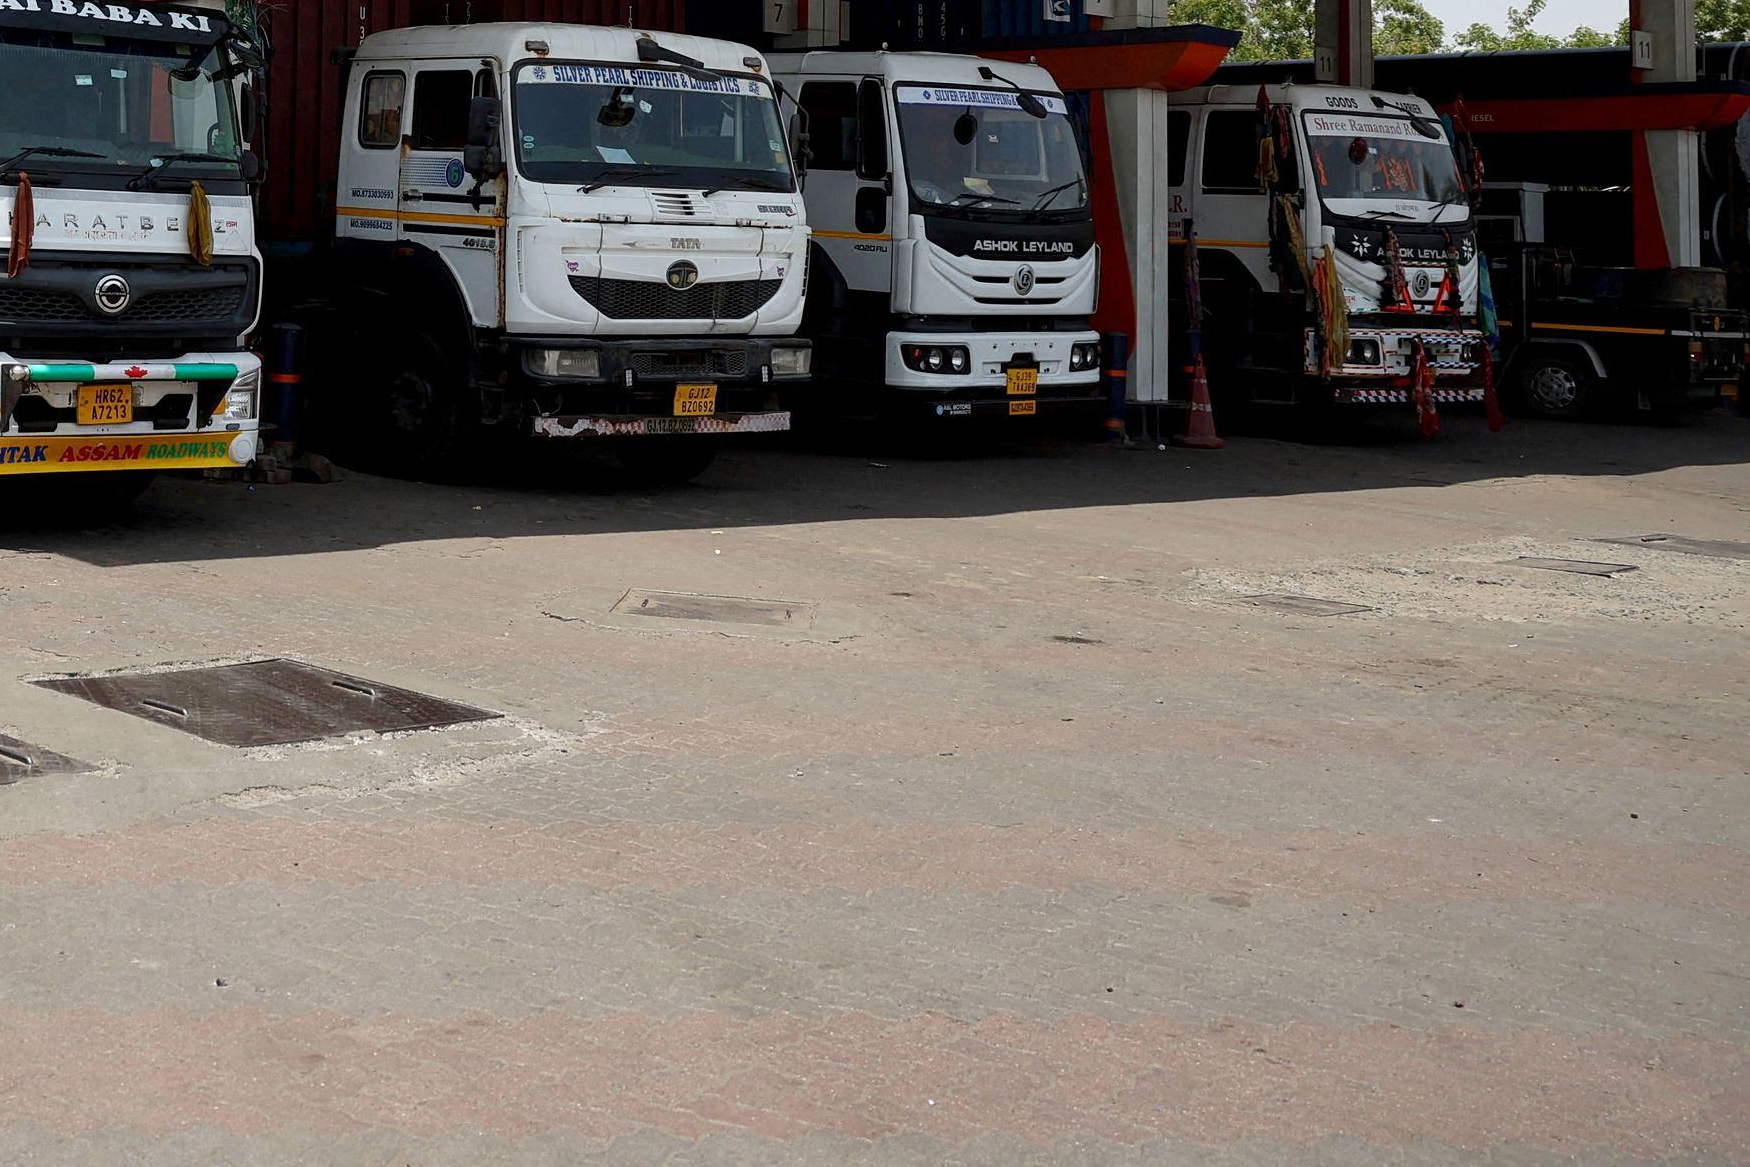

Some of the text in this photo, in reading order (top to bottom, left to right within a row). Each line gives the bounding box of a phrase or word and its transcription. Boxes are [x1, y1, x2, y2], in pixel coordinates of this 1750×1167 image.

[774, 3, 783, 22] 7
[168, 11, 212, 33] KI
[1639, 40, 1650, 59] 11
[1320, 56, 1331, 72] 11
[553, 65, 593, 83] SILVER
[594, 68, 630, 85] PEARL
[630, 70, 679, 89] SHIPPING
[681, 74, 689, 89] &
[934, 89, 959, 101] SILVER
[960, 91, 981, 103] PEARL
[981, 93, 1010, 105] SHIPPING
[1325, 96, 1359, 109] GOODS
[1314, 117, 1347, 131] Shree
[1348, 119, 1403, 135] Ramanand
[671, 237, 701, 249] TATA
[974, 239, 1074, 253] ASHOK LEYLAND
[1376, 246, 1459, 259] AOK LEYLAD
[95, 389, 124, 404] HR62
[688, 388, 711, 399] GJ12
[91, 404, 127, 421] A7213
[682, 400, 714, 412] BZ0692
[58, 444, 143, 463] ASSAM
[145, 441, 228, 461] ROADWAYS
